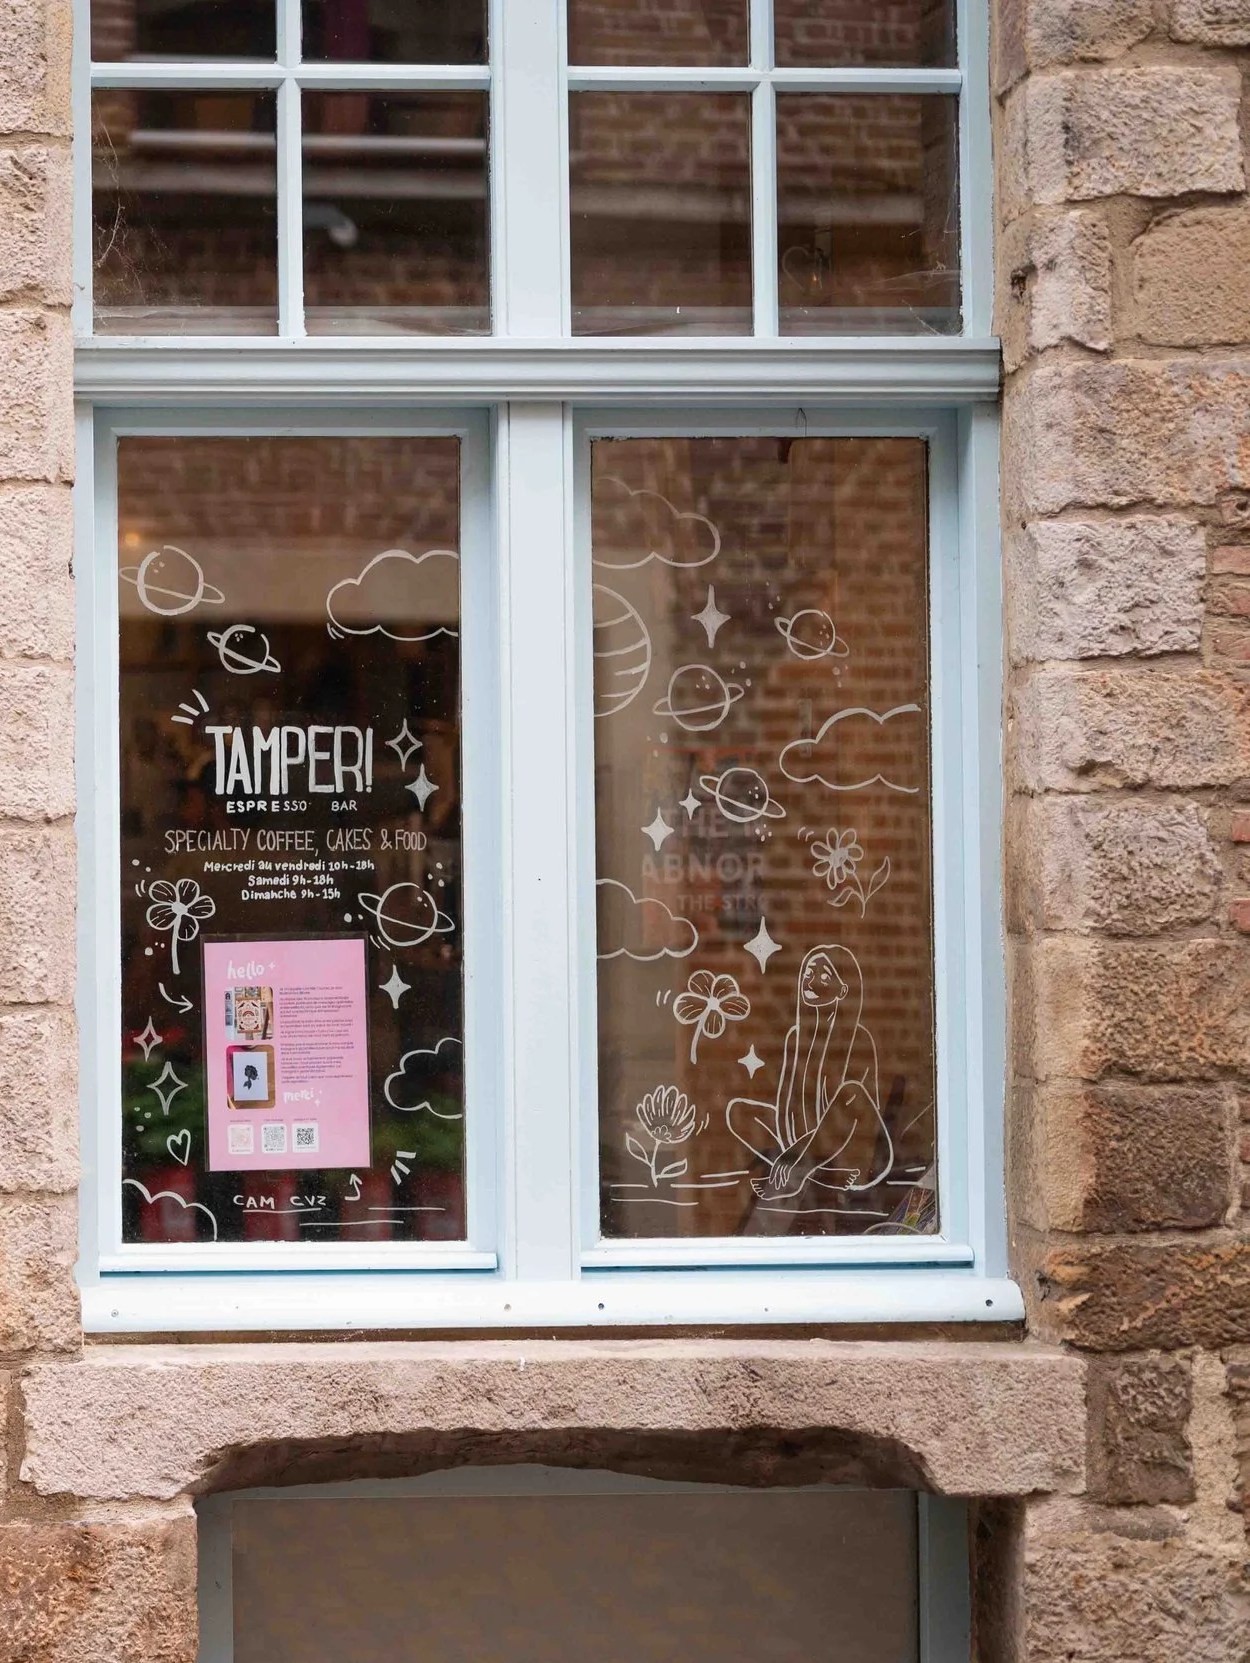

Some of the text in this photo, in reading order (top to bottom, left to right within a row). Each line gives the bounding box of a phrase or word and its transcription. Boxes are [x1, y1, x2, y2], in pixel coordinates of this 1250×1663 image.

[205, 725, 374, 796] TAMPER!
[226, 800, 358, 814] ESPRESSO BAR
[164, 828, 427, 857] SPECIALTY COFFEE, CAKES & FOOD
[203, 860, 256, 872] Mercredi
[257, 860, 273, 871] au
[275, 860, 326, 871] vendredi
[248, 874, 290, 886] Samedi
[241, 889, 297, 901] Dimanche
[227, 960, 265, 980] hello
[283, 1087, 315, 1104] merci
[233, 1194, 276, 1210] CAM
